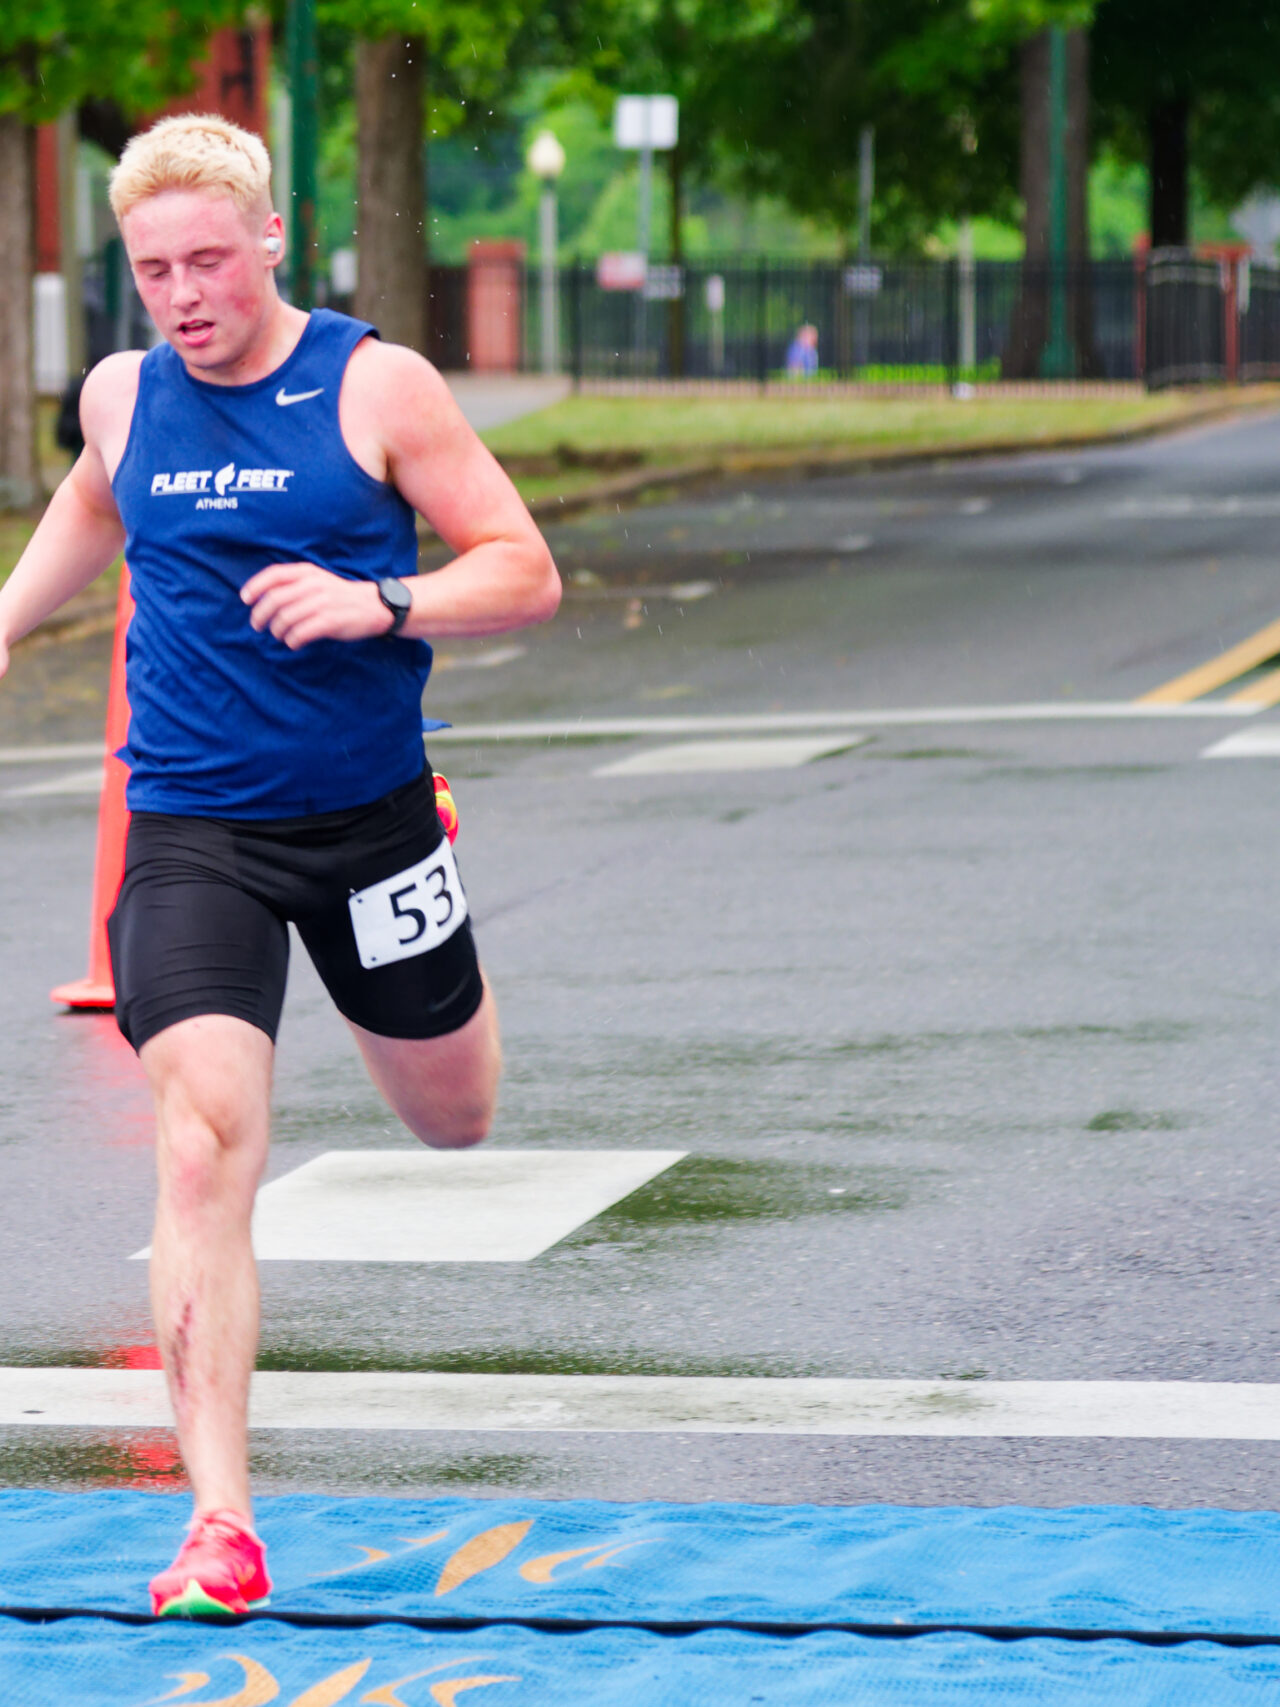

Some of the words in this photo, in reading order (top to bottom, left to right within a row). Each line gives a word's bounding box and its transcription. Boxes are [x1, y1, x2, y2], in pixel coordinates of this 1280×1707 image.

[151, 470, 213, 493] FLEET
[236, 469, 291, 489] FEET
[195, 497, 238, 510] ATHENS
[389, 865, 453, 945] 53
